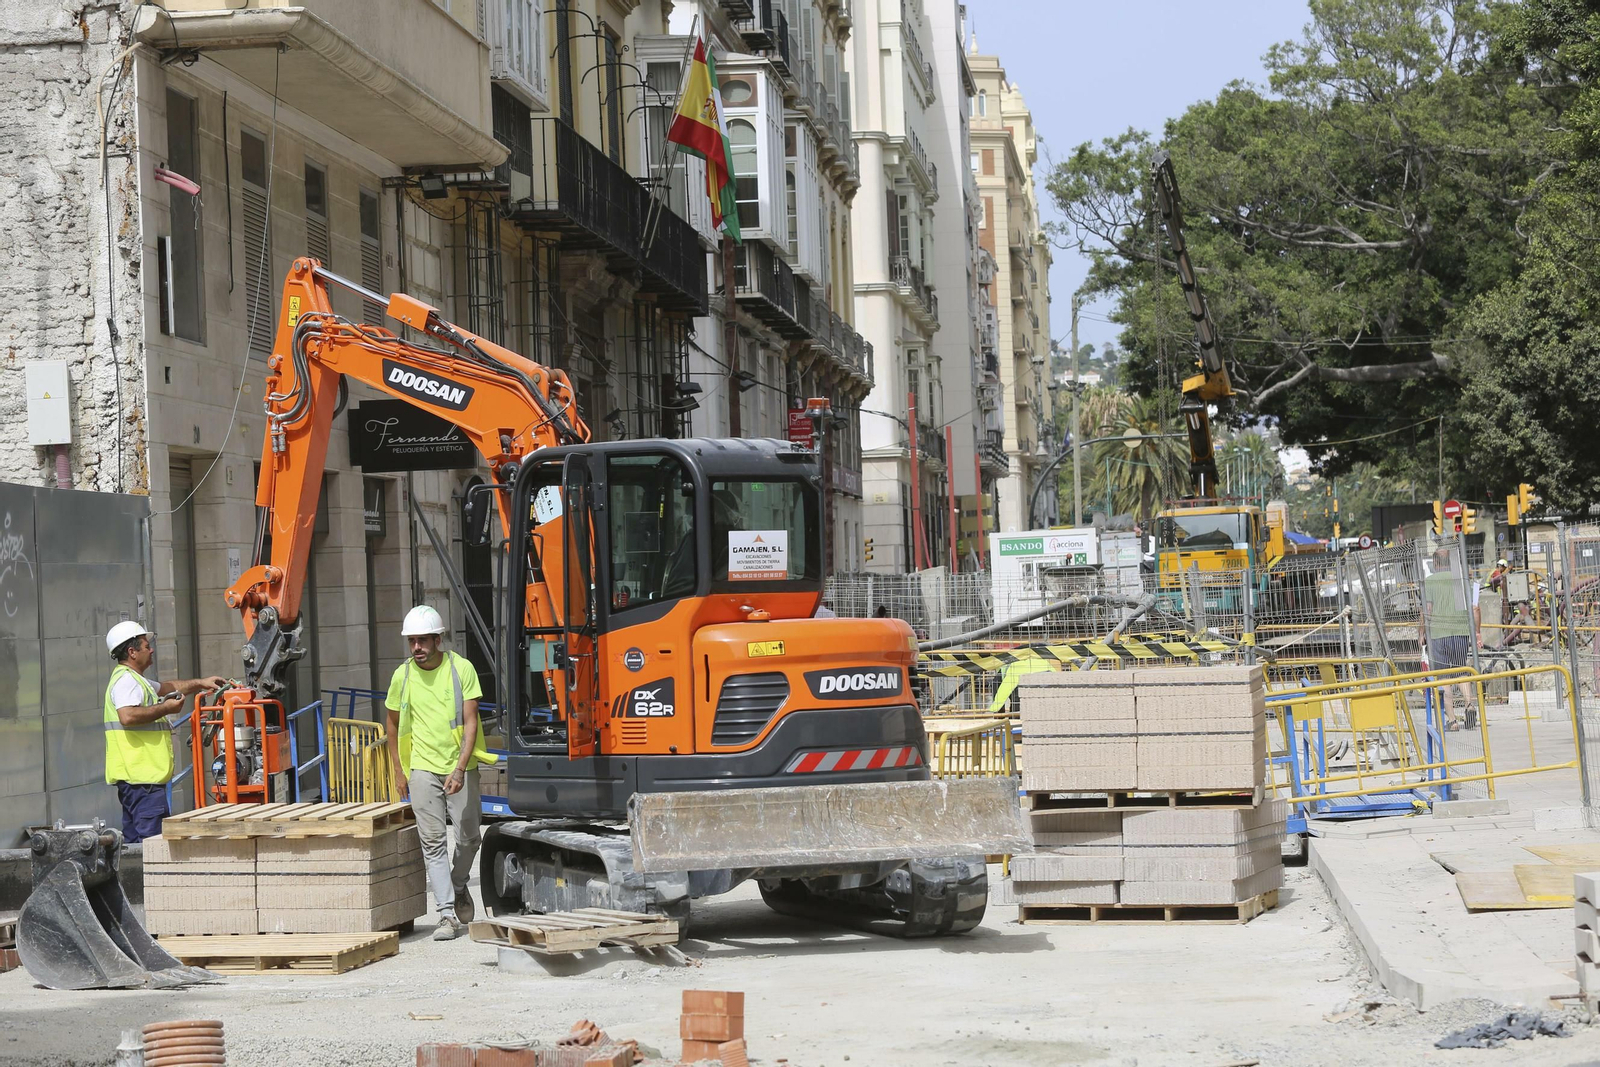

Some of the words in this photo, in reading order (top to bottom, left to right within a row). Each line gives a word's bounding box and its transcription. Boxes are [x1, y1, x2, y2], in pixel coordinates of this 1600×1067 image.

[388, 367, 466, 405] DOOSAN
[365, 417, 459, 452] Fernando
[392, 444, 429, 454] PELUQUERÍA
[435, 443, 464, 453] ESTÉTICA
[732, 546, 770, 554] GAMAJEN,
[1006, 542, 1043, 551] SANDO
[818, 673, 899, 694] DOOSAN
[634, 687, 662, 700] DX
[634, 701, 674, 716] 62R
